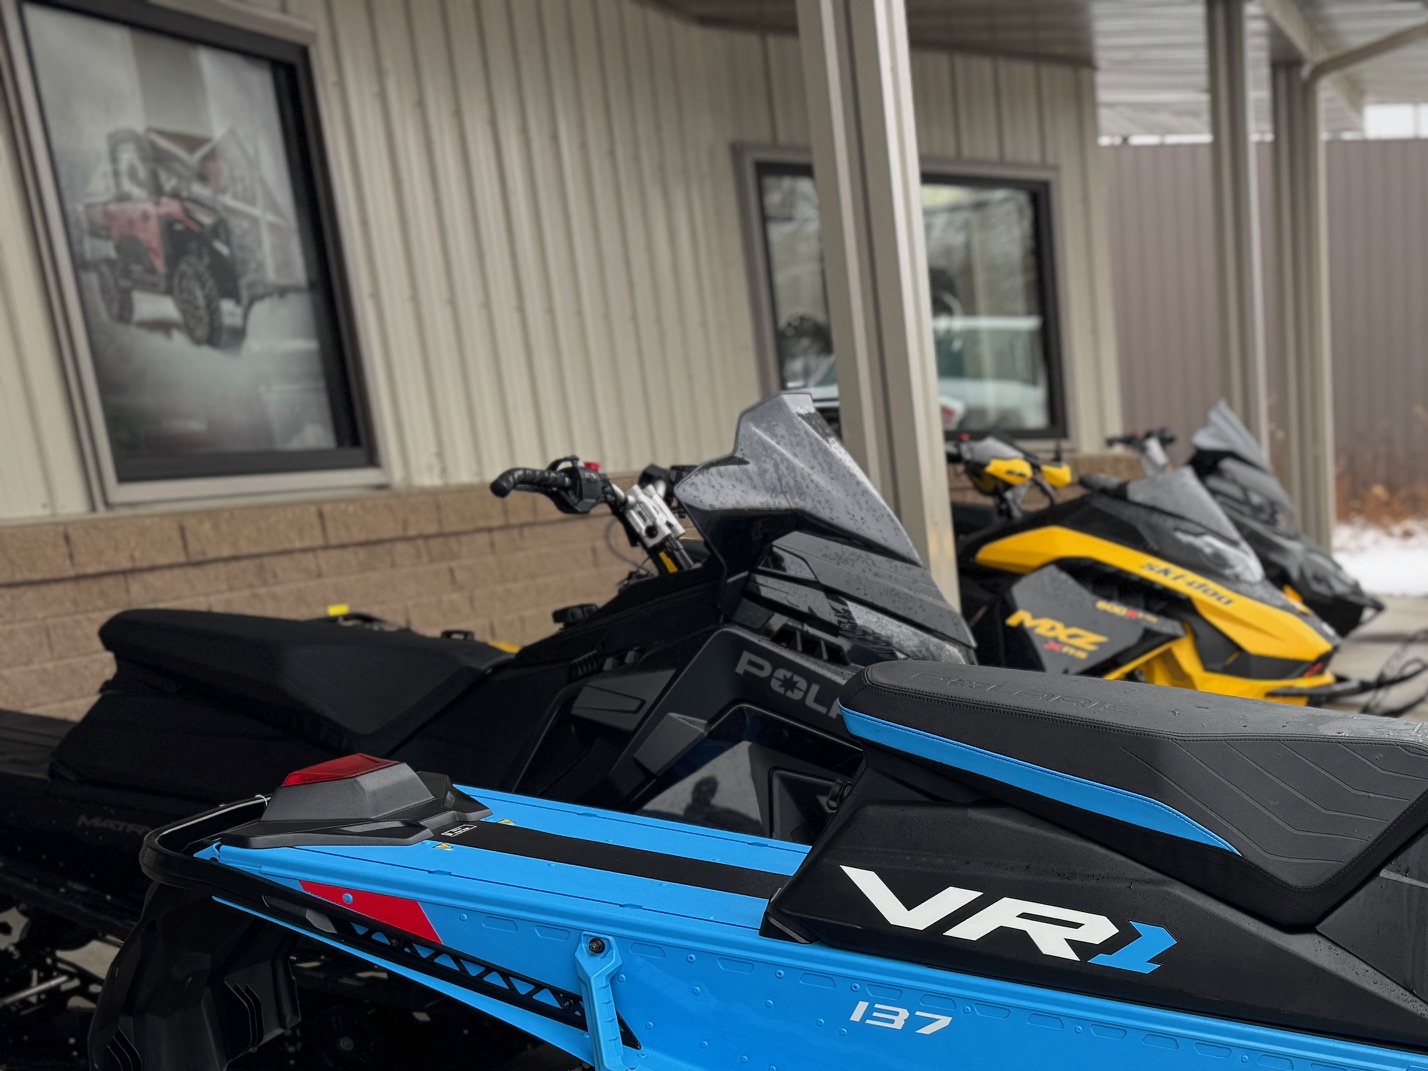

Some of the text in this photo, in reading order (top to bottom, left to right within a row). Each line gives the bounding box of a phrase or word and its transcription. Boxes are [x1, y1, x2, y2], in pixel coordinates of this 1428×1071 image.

[1005, 609, 1109, 652] MXZ
[839, 865, 1178, 974] VR1
[850, 1001, 952, 1035] 137
